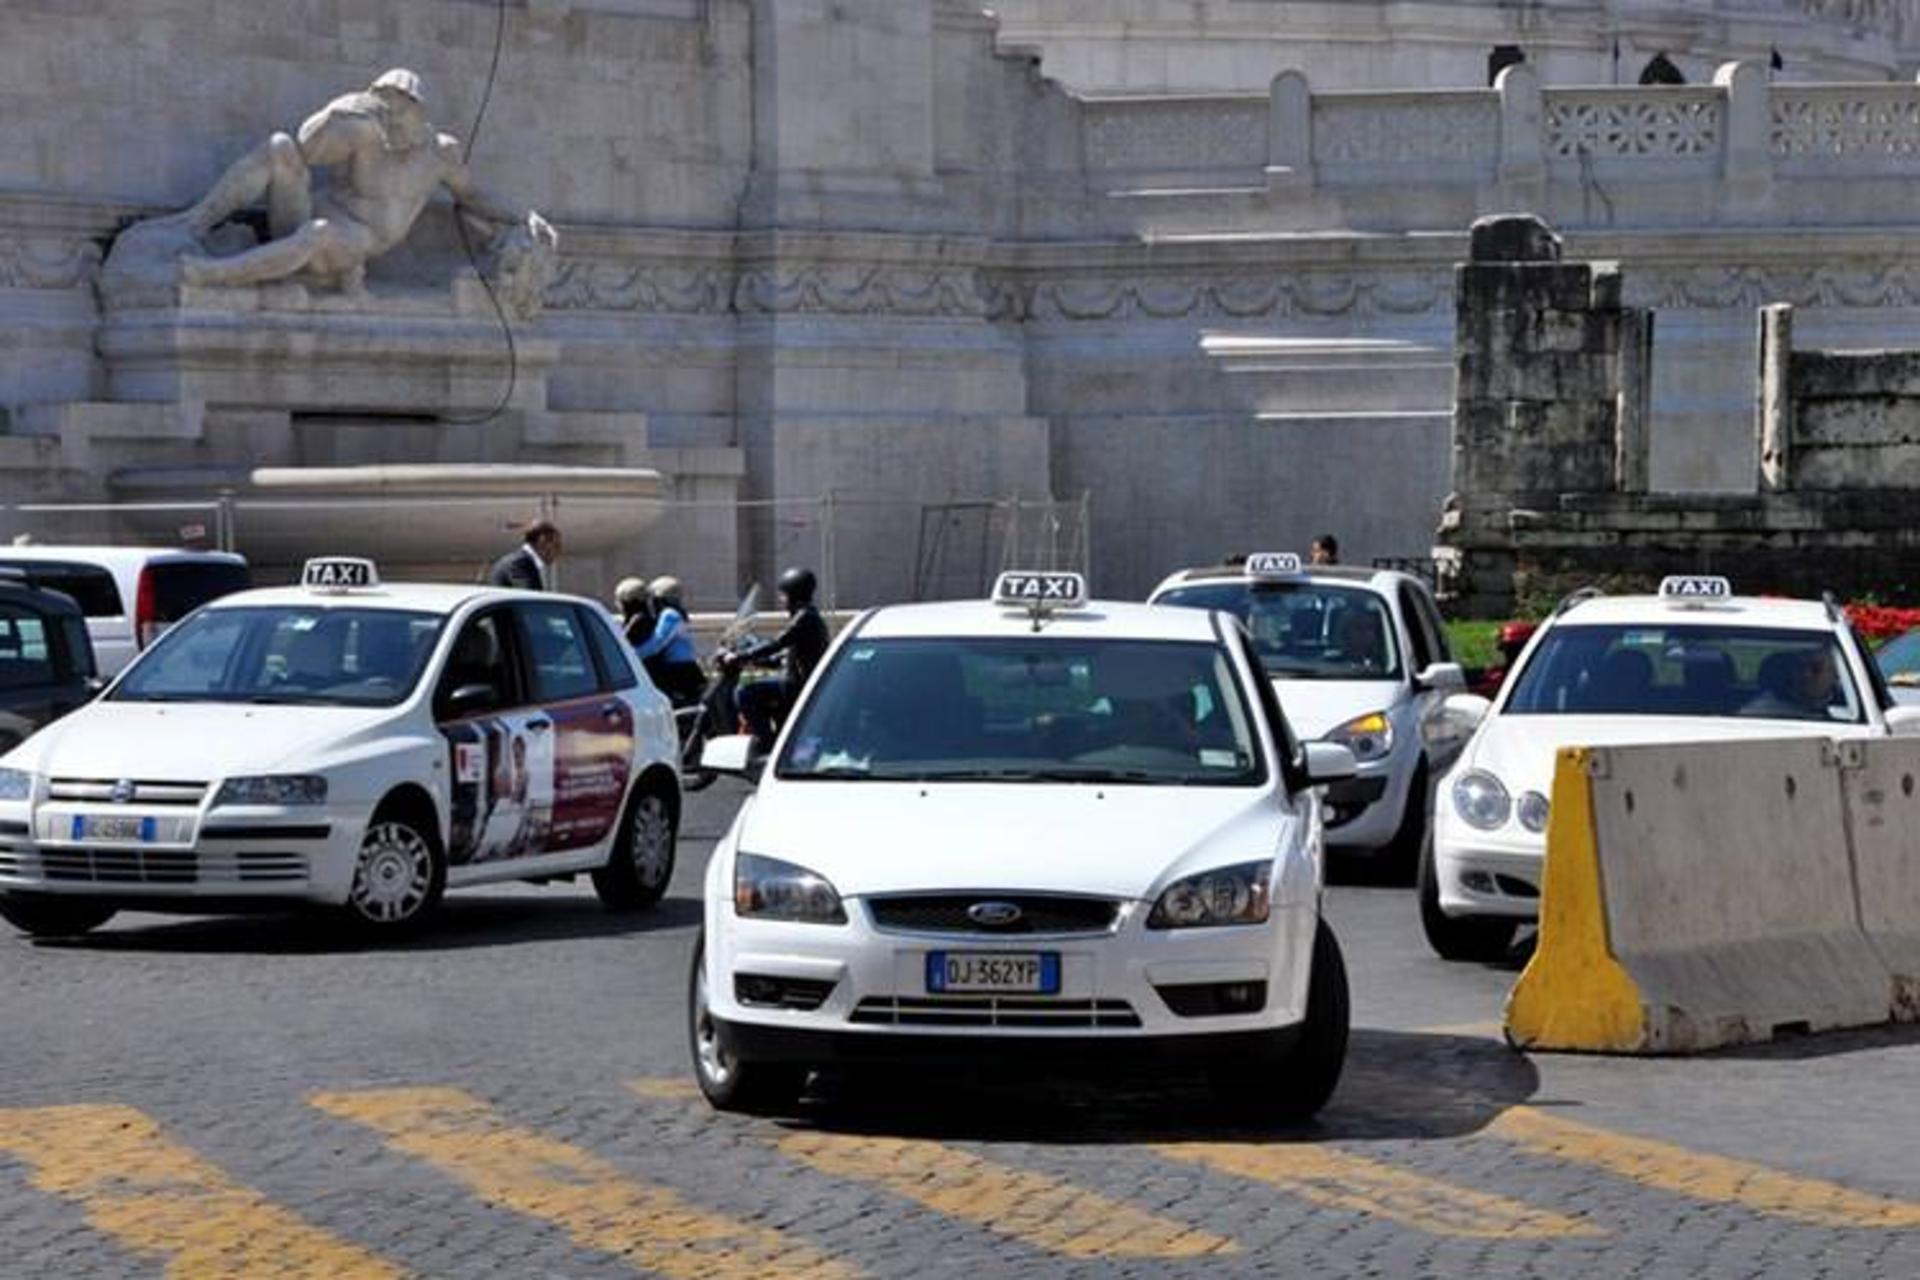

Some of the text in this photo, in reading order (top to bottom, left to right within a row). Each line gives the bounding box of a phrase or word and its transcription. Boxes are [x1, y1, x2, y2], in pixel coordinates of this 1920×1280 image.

[1252, 556, 1293, 571] TAXI
[309, 563, 364, 583] TAXI
[1005, 578, 1075, 597] TAXI
[1667, 579, 1721, 596] TAXI
